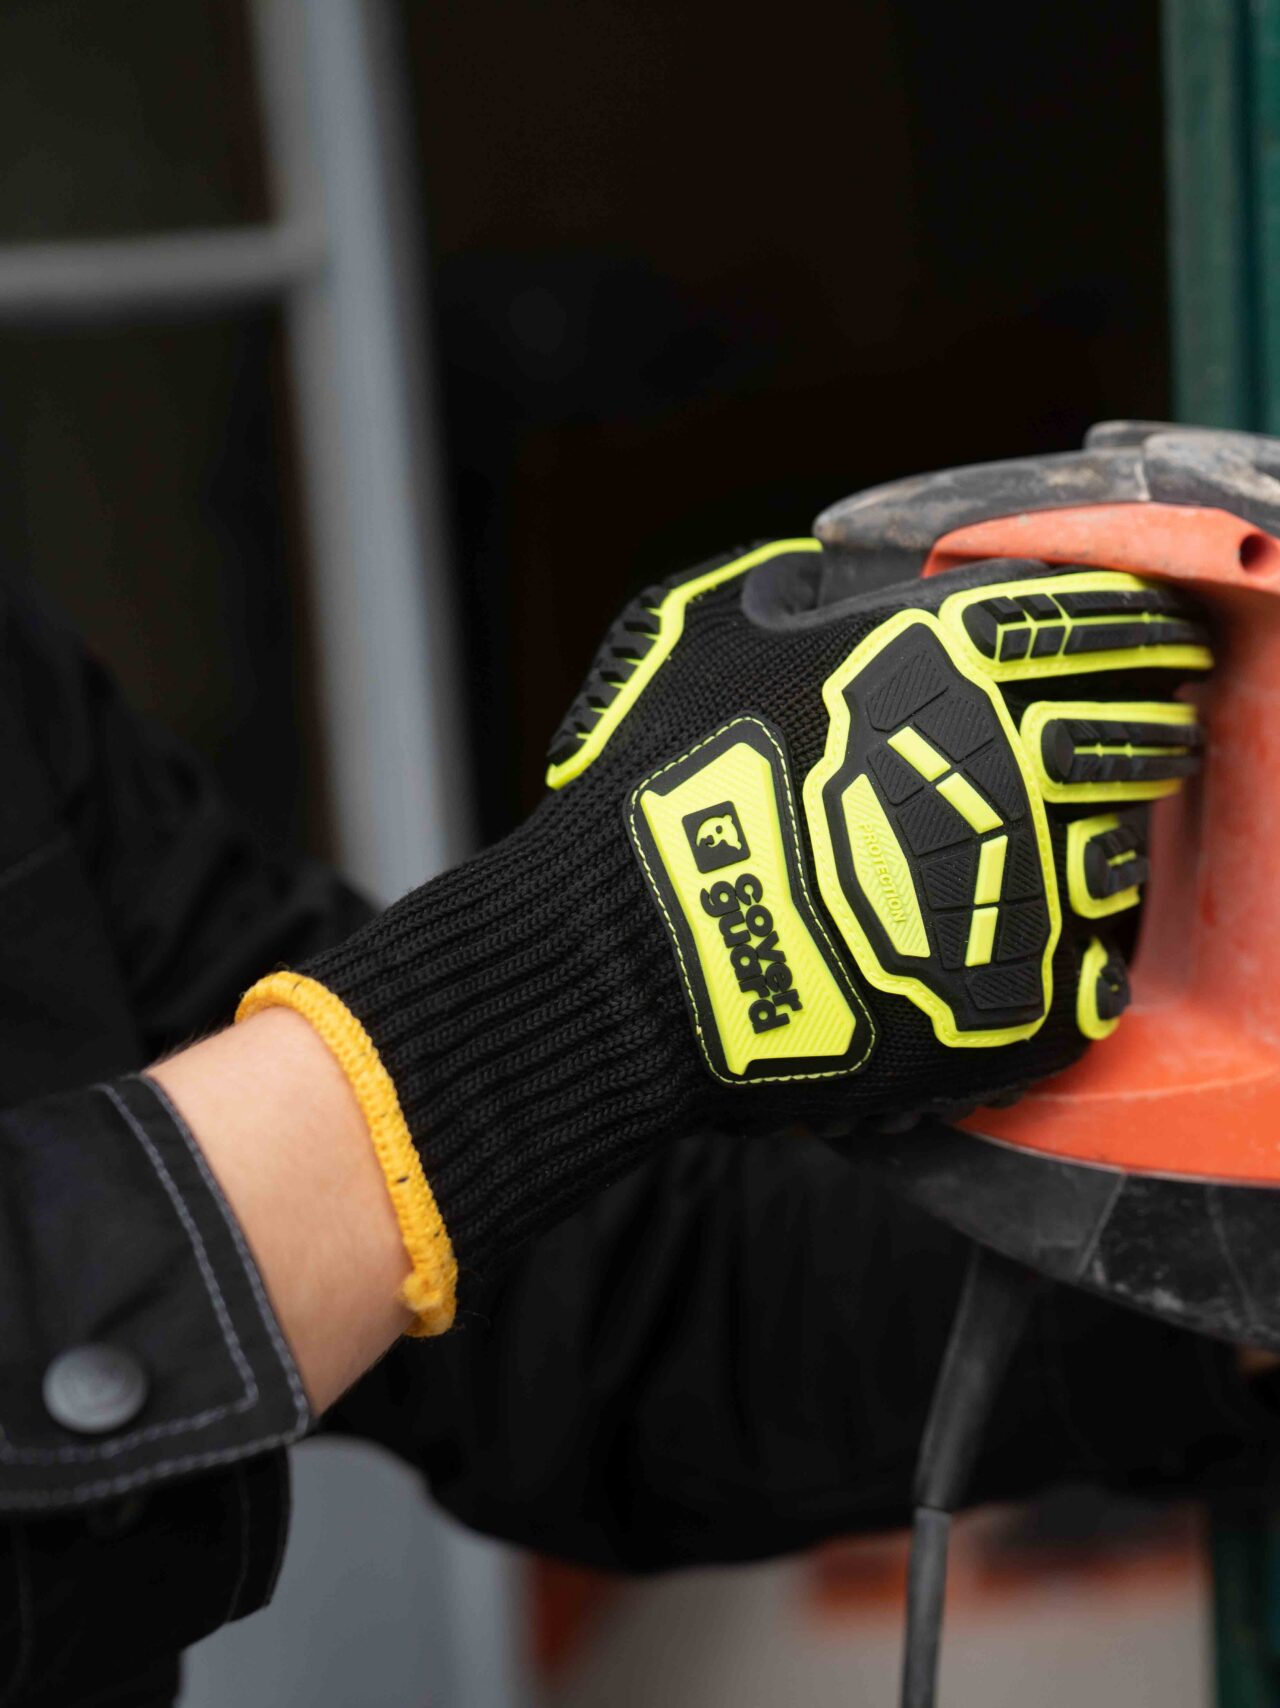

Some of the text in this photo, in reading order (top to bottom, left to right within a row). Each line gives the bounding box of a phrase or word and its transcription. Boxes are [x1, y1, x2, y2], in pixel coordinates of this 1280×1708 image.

[735, 873, 802, 1012] cover
[860, 823, 907, 924] PROTECTION
[700, 881, 790, 1034] guard
